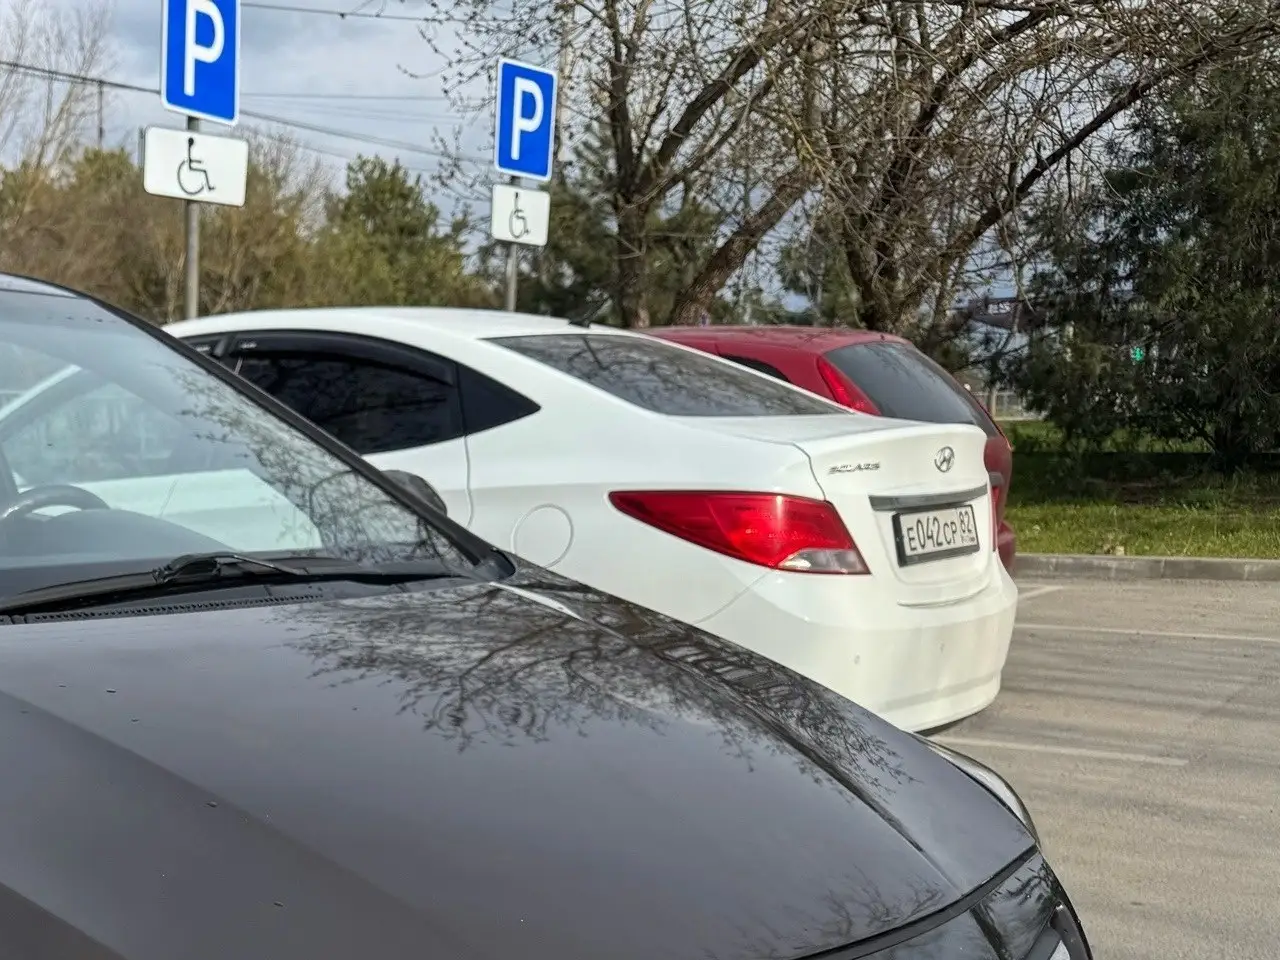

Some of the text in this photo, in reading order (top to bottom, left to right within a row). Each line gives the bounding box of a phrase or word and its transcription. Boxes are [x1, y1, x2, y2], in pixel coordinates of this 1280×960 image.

[183, 0, 225, 97] P
[511, 76, 544, 161] P
[959, 510, 973, 533] 82
